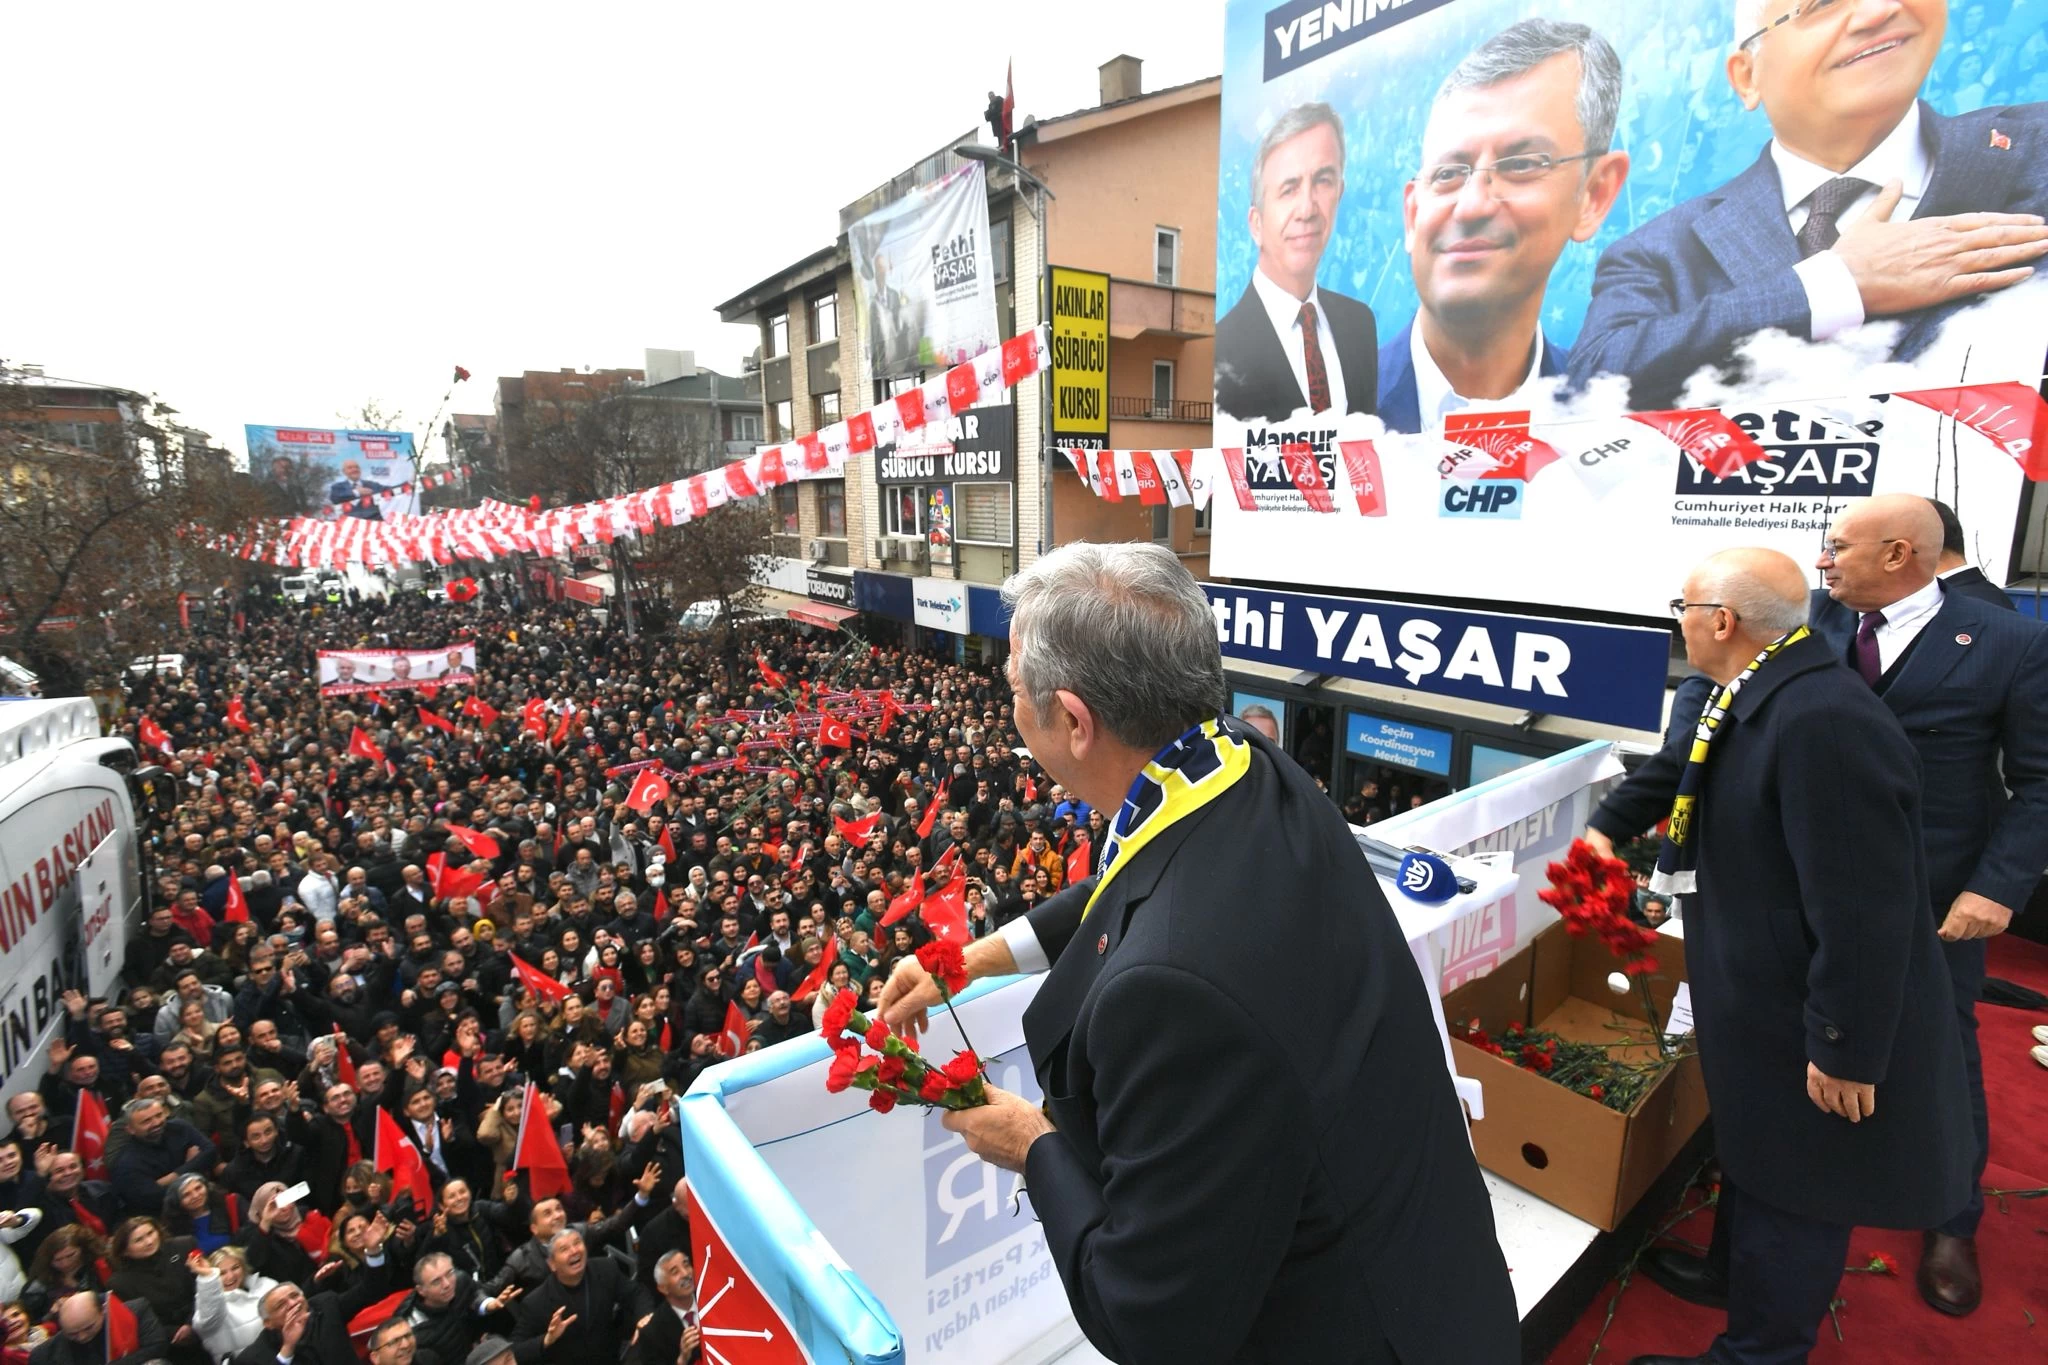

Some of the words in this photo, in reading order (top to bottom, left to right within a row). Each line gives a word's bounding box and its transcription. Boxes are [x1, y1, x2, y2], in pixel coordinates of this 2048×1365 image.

[931, 228, 975, 265] Fethi
[933, 256, 976, 285] YAŞAR
[1055, 285, 1104, 320] AKINLAR
[1055, 329, 1104, 373] SÜRÜCÜ
[1059, 386, 1100, 420] KURSU
[949, 415, 979, 441] AR
[1499, 440, 1533, 468] CHP
[1579, 438, 1631, 467] CHP
[1691, 433, 1731, 461] HP
[943, 450, 1001, 476] KURSU
[1437, 448, 1473, 475] CHP
[1684, 448, 1872, 495] YAŞAR
[1444, 484, 1518, 513] CHP
[1674, 500, 1765, 515] Cumhuriyet
[1769, 502, 1807, 513] Halk
[1812, 502, 1848, 514] Par
[1671, 516, 1732, 527] Yenimahalle
[1734, 517, 1789, 530] Belediyesi
[916, 598, 928, 608] Türk
[929, 598, 952, 612] Telekom
[1213, 597, 1285, 652] thi
[1305, 606, 1569, 698] YAŞAR
[1359, 732, 1436, 758] Koordinasyon
[1380, 724, 1414, 740] Seçim
[1374, 749, 1419, 768] Merkezi
